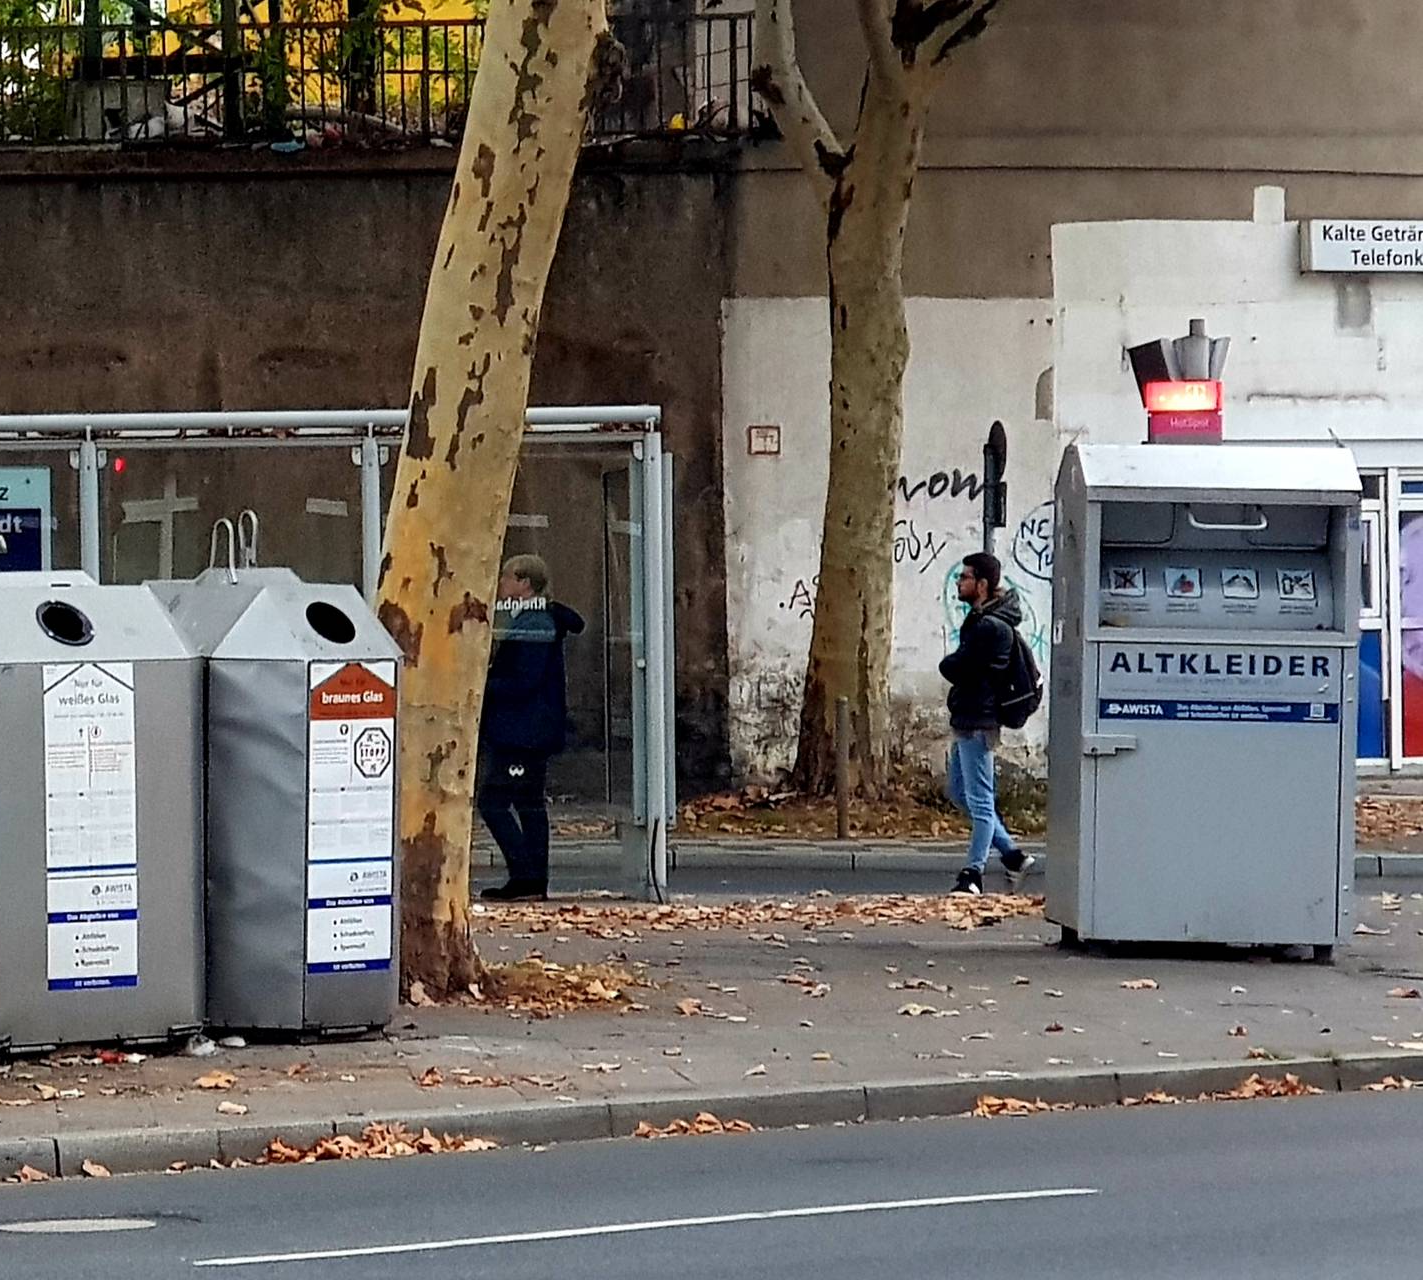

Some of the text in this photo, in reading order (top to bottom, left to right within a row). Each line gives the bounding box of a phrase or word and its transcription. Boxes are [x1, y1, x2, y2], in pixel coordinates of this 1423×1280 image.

[1322, 224, 1366, 241] Kalte
[1351, 249, 1423, 266] Telefonk
[1110, 652, 1330, 677] ALTKLEIDER
[58, 692, 120, 705] weißes Glas
[322, 690, 383, 704] braunes Glas
[1121, 703, 1164, 715] AWISTA
